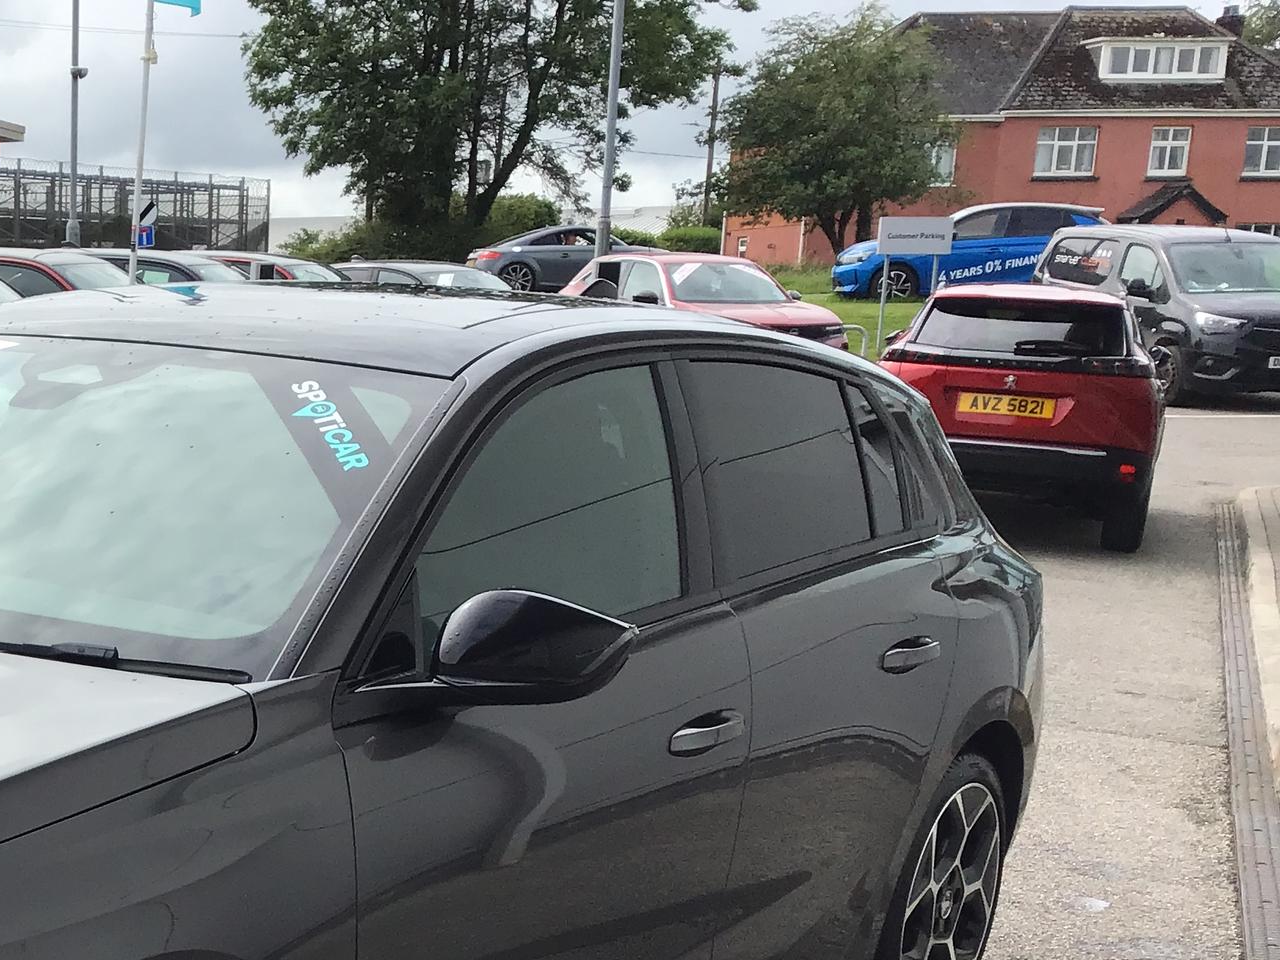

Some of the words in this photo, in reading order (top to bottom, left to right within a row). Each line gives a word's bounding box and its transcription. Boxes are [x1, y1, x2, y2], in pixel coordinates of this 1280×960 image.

[887, 232, 919, 240] Customer
[920, 232, 945, 241] Parking
[950, 264, 983, 280] YEARS
[985, 259, 1002, 273] 0%
[969, 396, 1003, 412] AVZ
[1007, 398, 1046, 416] 5821
